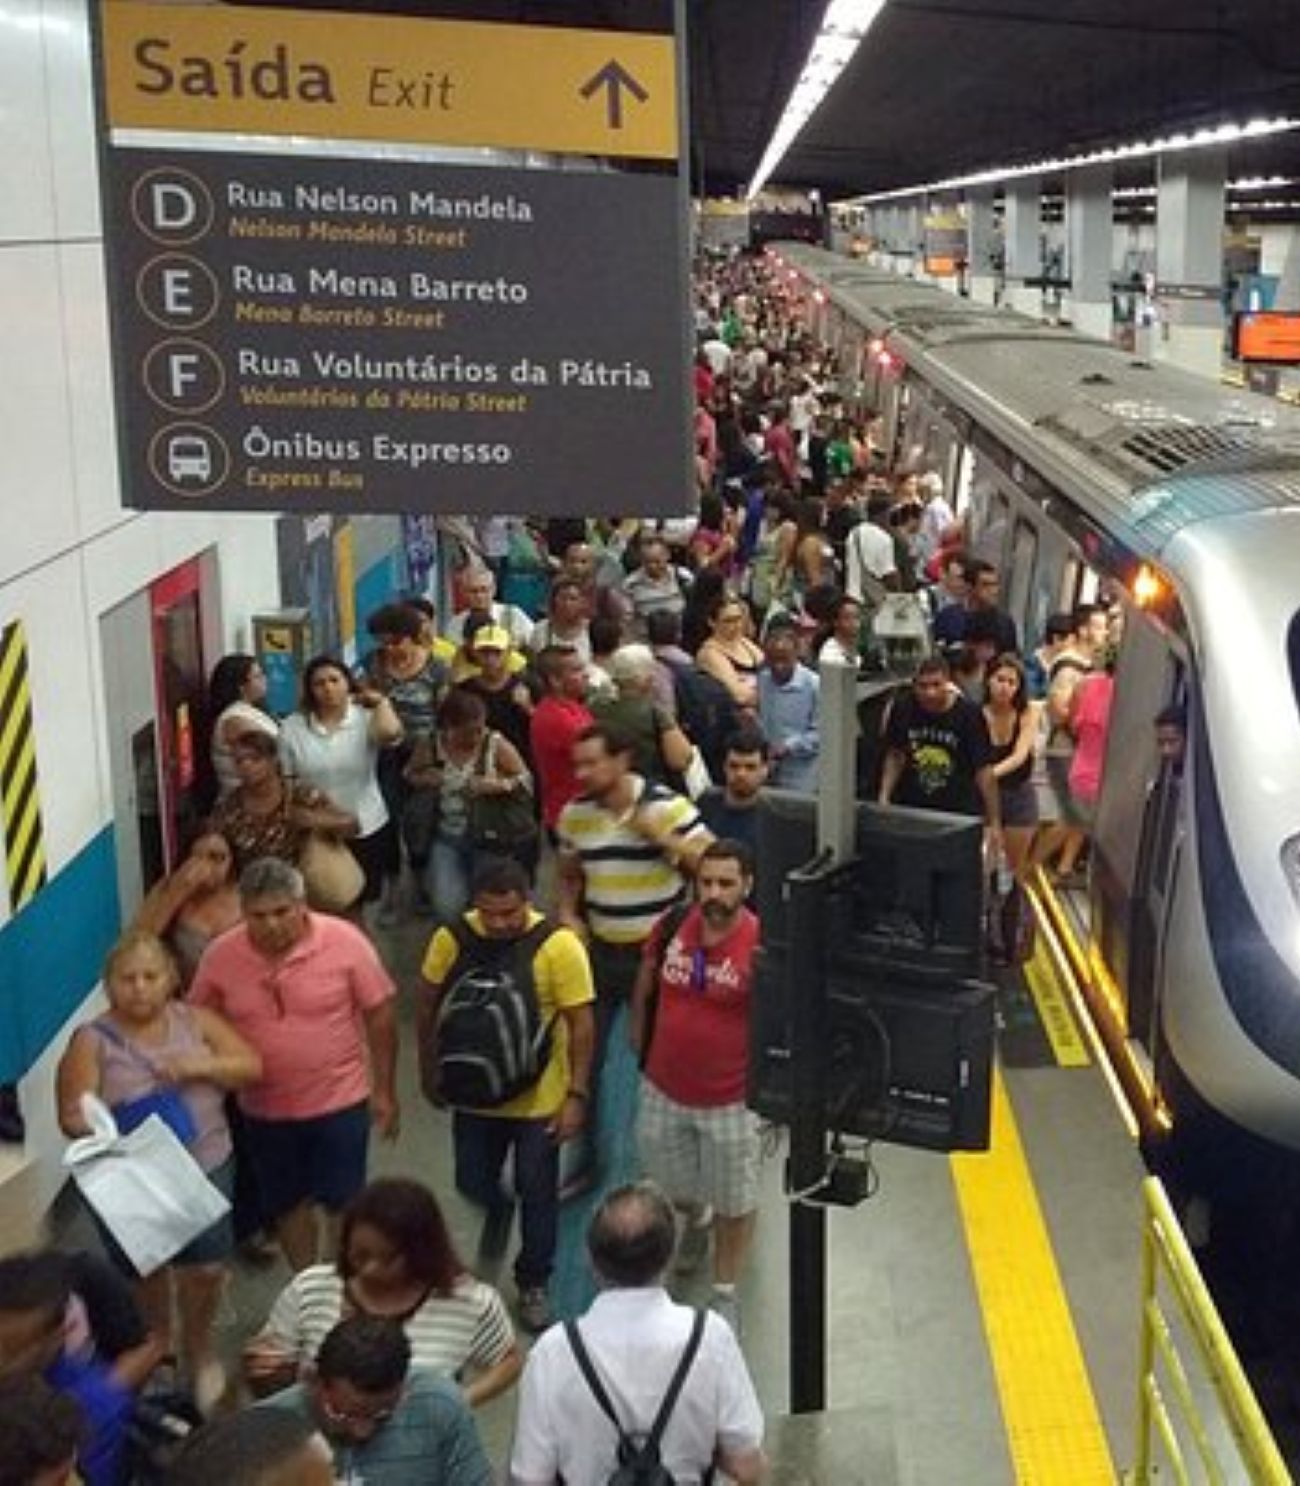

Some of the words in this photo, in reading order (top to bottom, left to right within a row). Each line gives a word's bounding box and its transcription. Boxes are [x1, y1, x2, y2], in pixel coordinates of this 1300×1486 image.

[134, 37, 336, 104] Saída
[368, 67, 456, 111] Exit
[152, 183, 197, 229] D
[227, 181, 284, 209] Rua
[295, 184, 398, 215] Nelson
[409, 190, 534, 222] Mandela
[228, 216, 300, 238] Nelson
[307, 220, 398, 245] Mandela
[404, 224, 468, 248] Street
[162, 268, 193, 314] E
[232, 264, 297, 293] Rua
[308, 267, 398, 298] Mena
[409, 272, 529, 304] Barreto
[234, 301, 294, 324] Mena
[299, 304, 375, 327] Barreto
[382, 307, 447, 329] Street
[168, 354, 198, 398] F
[238, 350, 300, 377] Rua
[312, 351, 499, 383] Voluntários
[509, 357, 549, 385] da
[559, 358, 653, 389] Pátria
[240, 385, 357, 409] Voluntários
[365, 388, 390, 408] da
[396, 390, 460, 411] Pátria
[466, 391, 529, 413] Street
[242, 425, 361, 461] Ônibus
[372, 435, 512, 469] Expresso
[246, 467, 322, 490] Express
[327, 469, 364, 489] Bus
